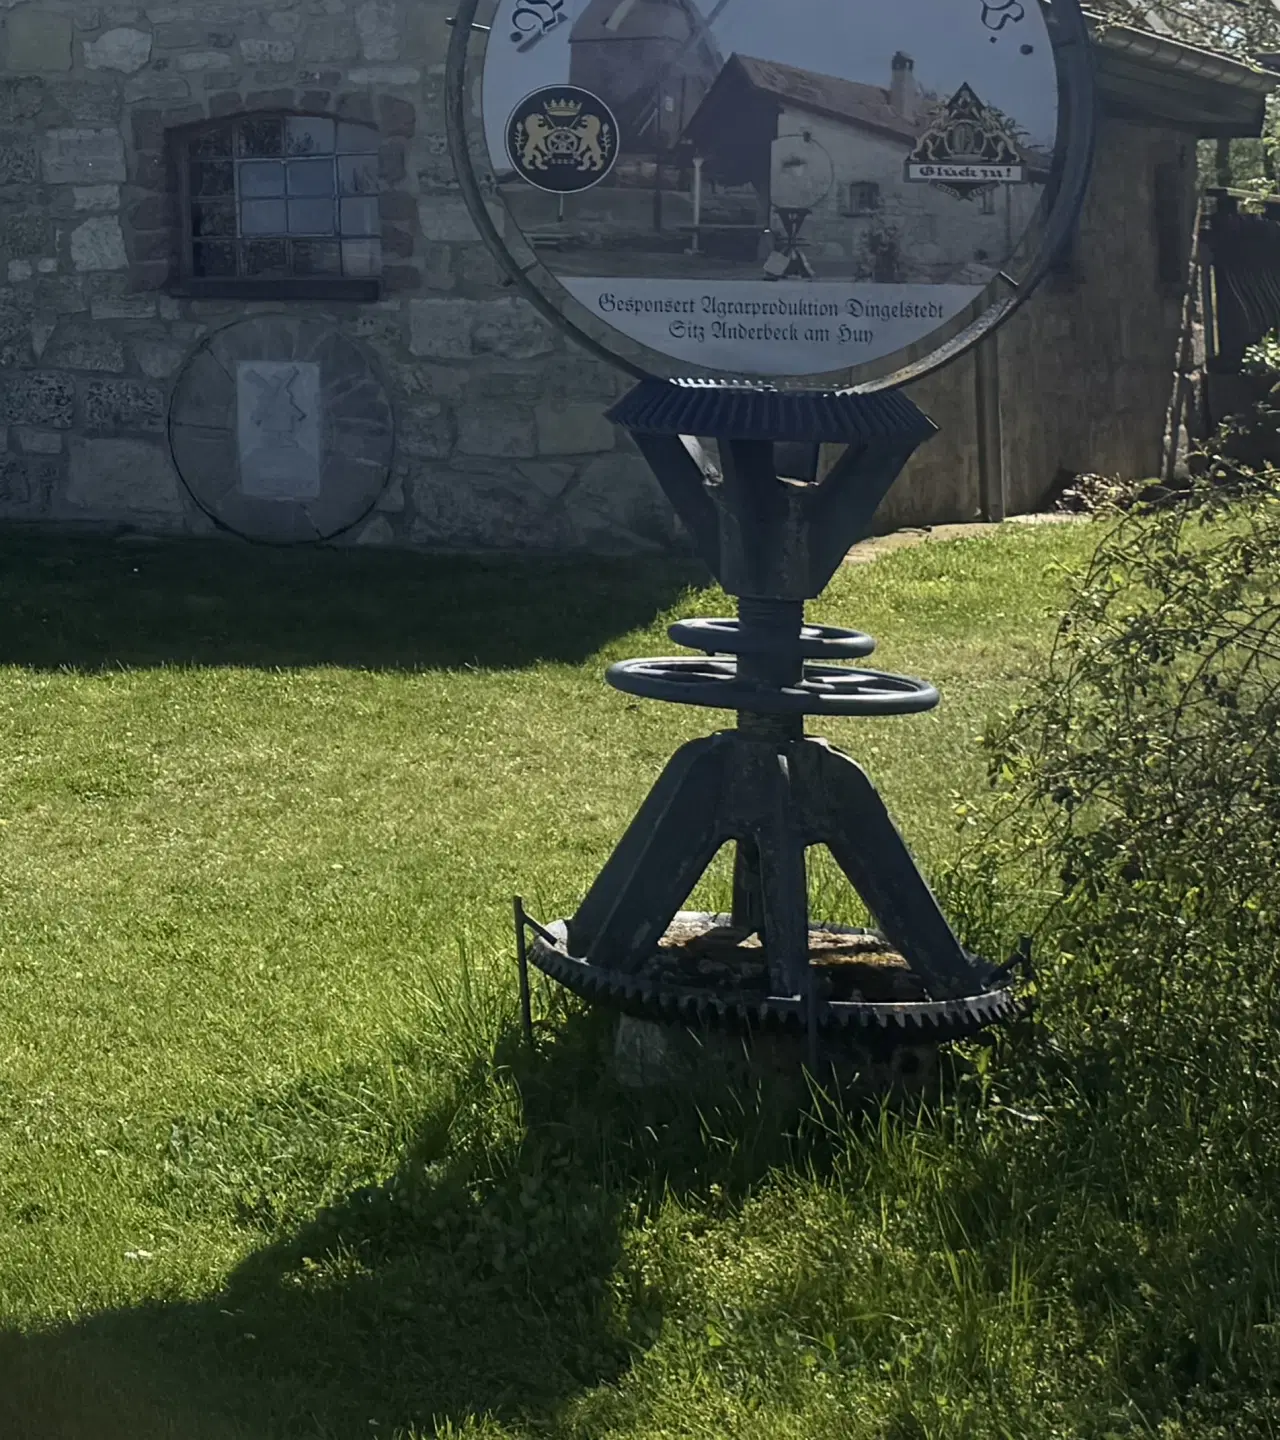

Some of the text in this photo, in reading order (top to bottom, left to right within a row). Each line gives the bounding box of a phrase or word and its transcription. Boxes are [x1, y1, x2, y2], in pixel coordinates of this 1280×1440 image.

[919, 165, 977, 178] Glück
[597, 293, 944, 321] Gesponsert Agrarproduktion Dingelstedt
[668, 320, 874, 346] Sitz Anderbeck am Huy
